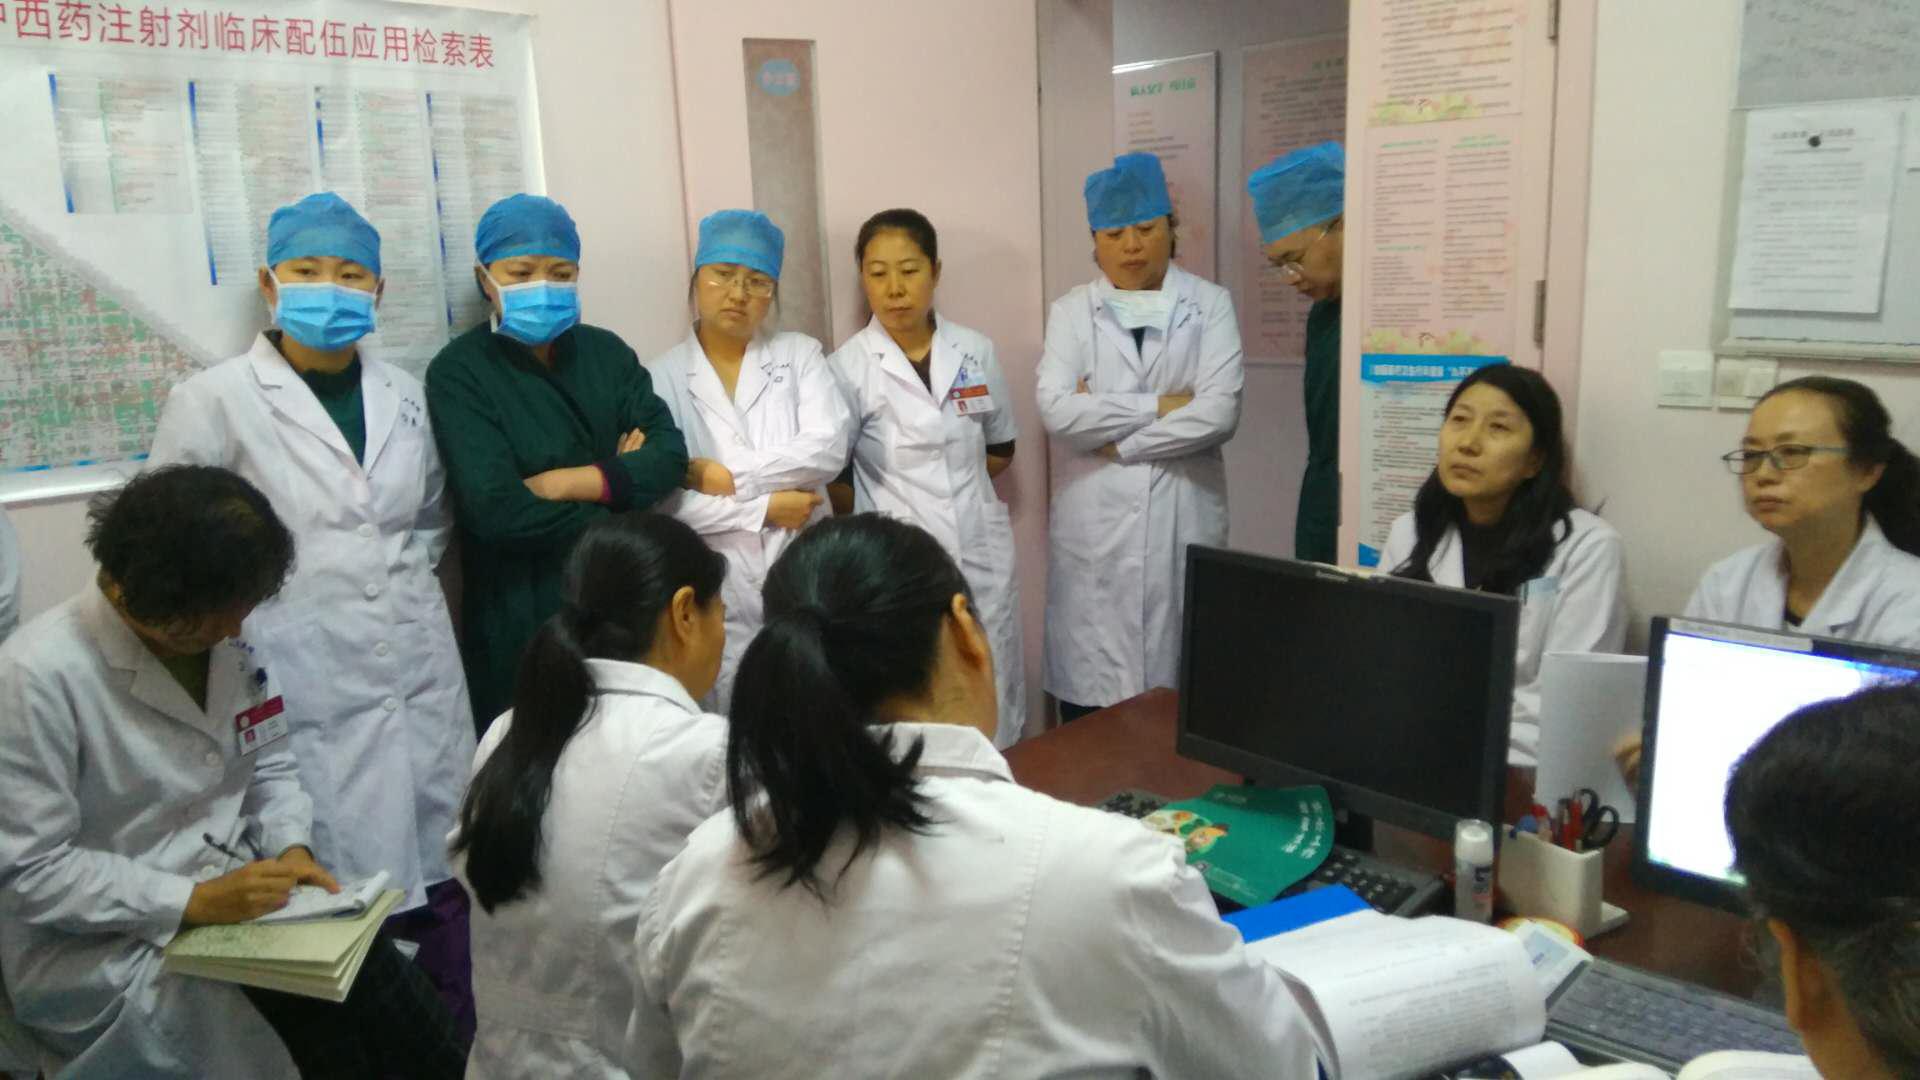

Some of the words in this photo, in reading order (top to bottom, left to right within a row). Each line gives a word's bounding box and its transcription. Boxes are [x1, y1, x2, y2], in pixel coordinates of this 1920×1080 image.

[0, 0, 494, 68] 西药注射剂临床配伍应用检索表
